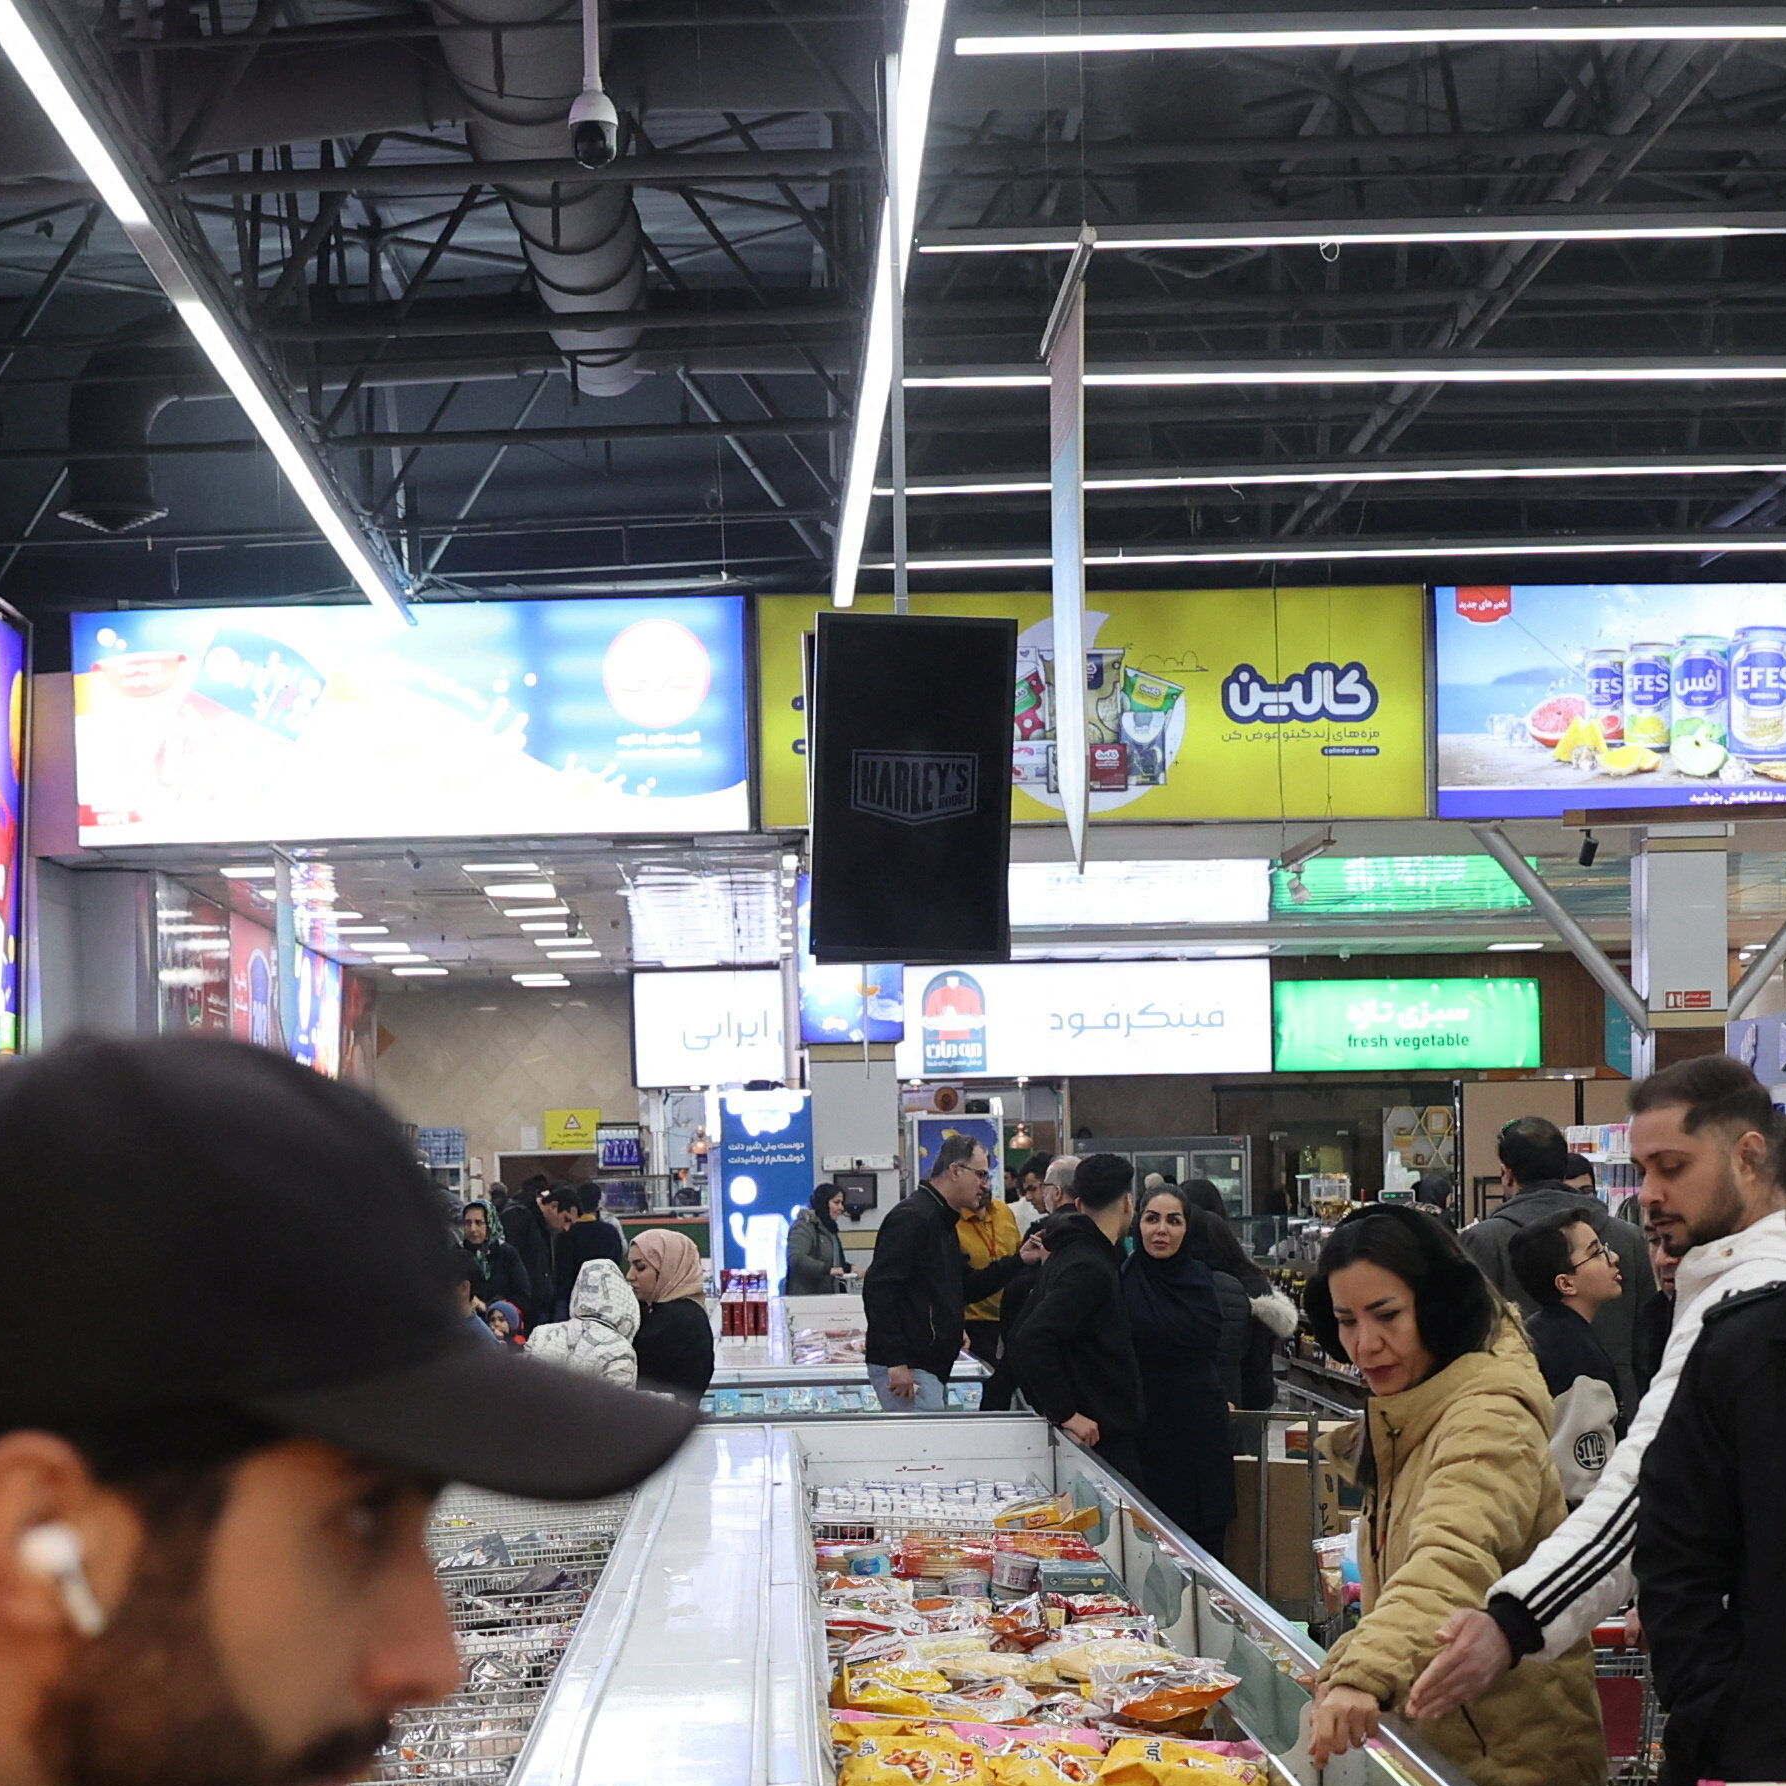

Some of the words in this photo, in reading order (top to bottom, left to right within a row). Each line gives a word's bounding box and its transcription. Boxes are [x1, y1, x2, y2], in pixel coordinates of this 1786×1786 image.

[1228, 669, 1372, 718] کالین
[1625, 673, 1670, 694] EFES
[1221, 729, 1243, 743] کن
[1245, 729, 1280, 744] عوض
[860, 759, 970, 815] HARLEY'S
[1346, 999, 1394, 1031] تازه
[1398, 1001, 1471, 1030] سبزی
[682, 1010, 768, 1051] ایرانی
[1347, 1034, 1388, 1048] fresh
[1394, 1033, 1471, 1051] vegetable
